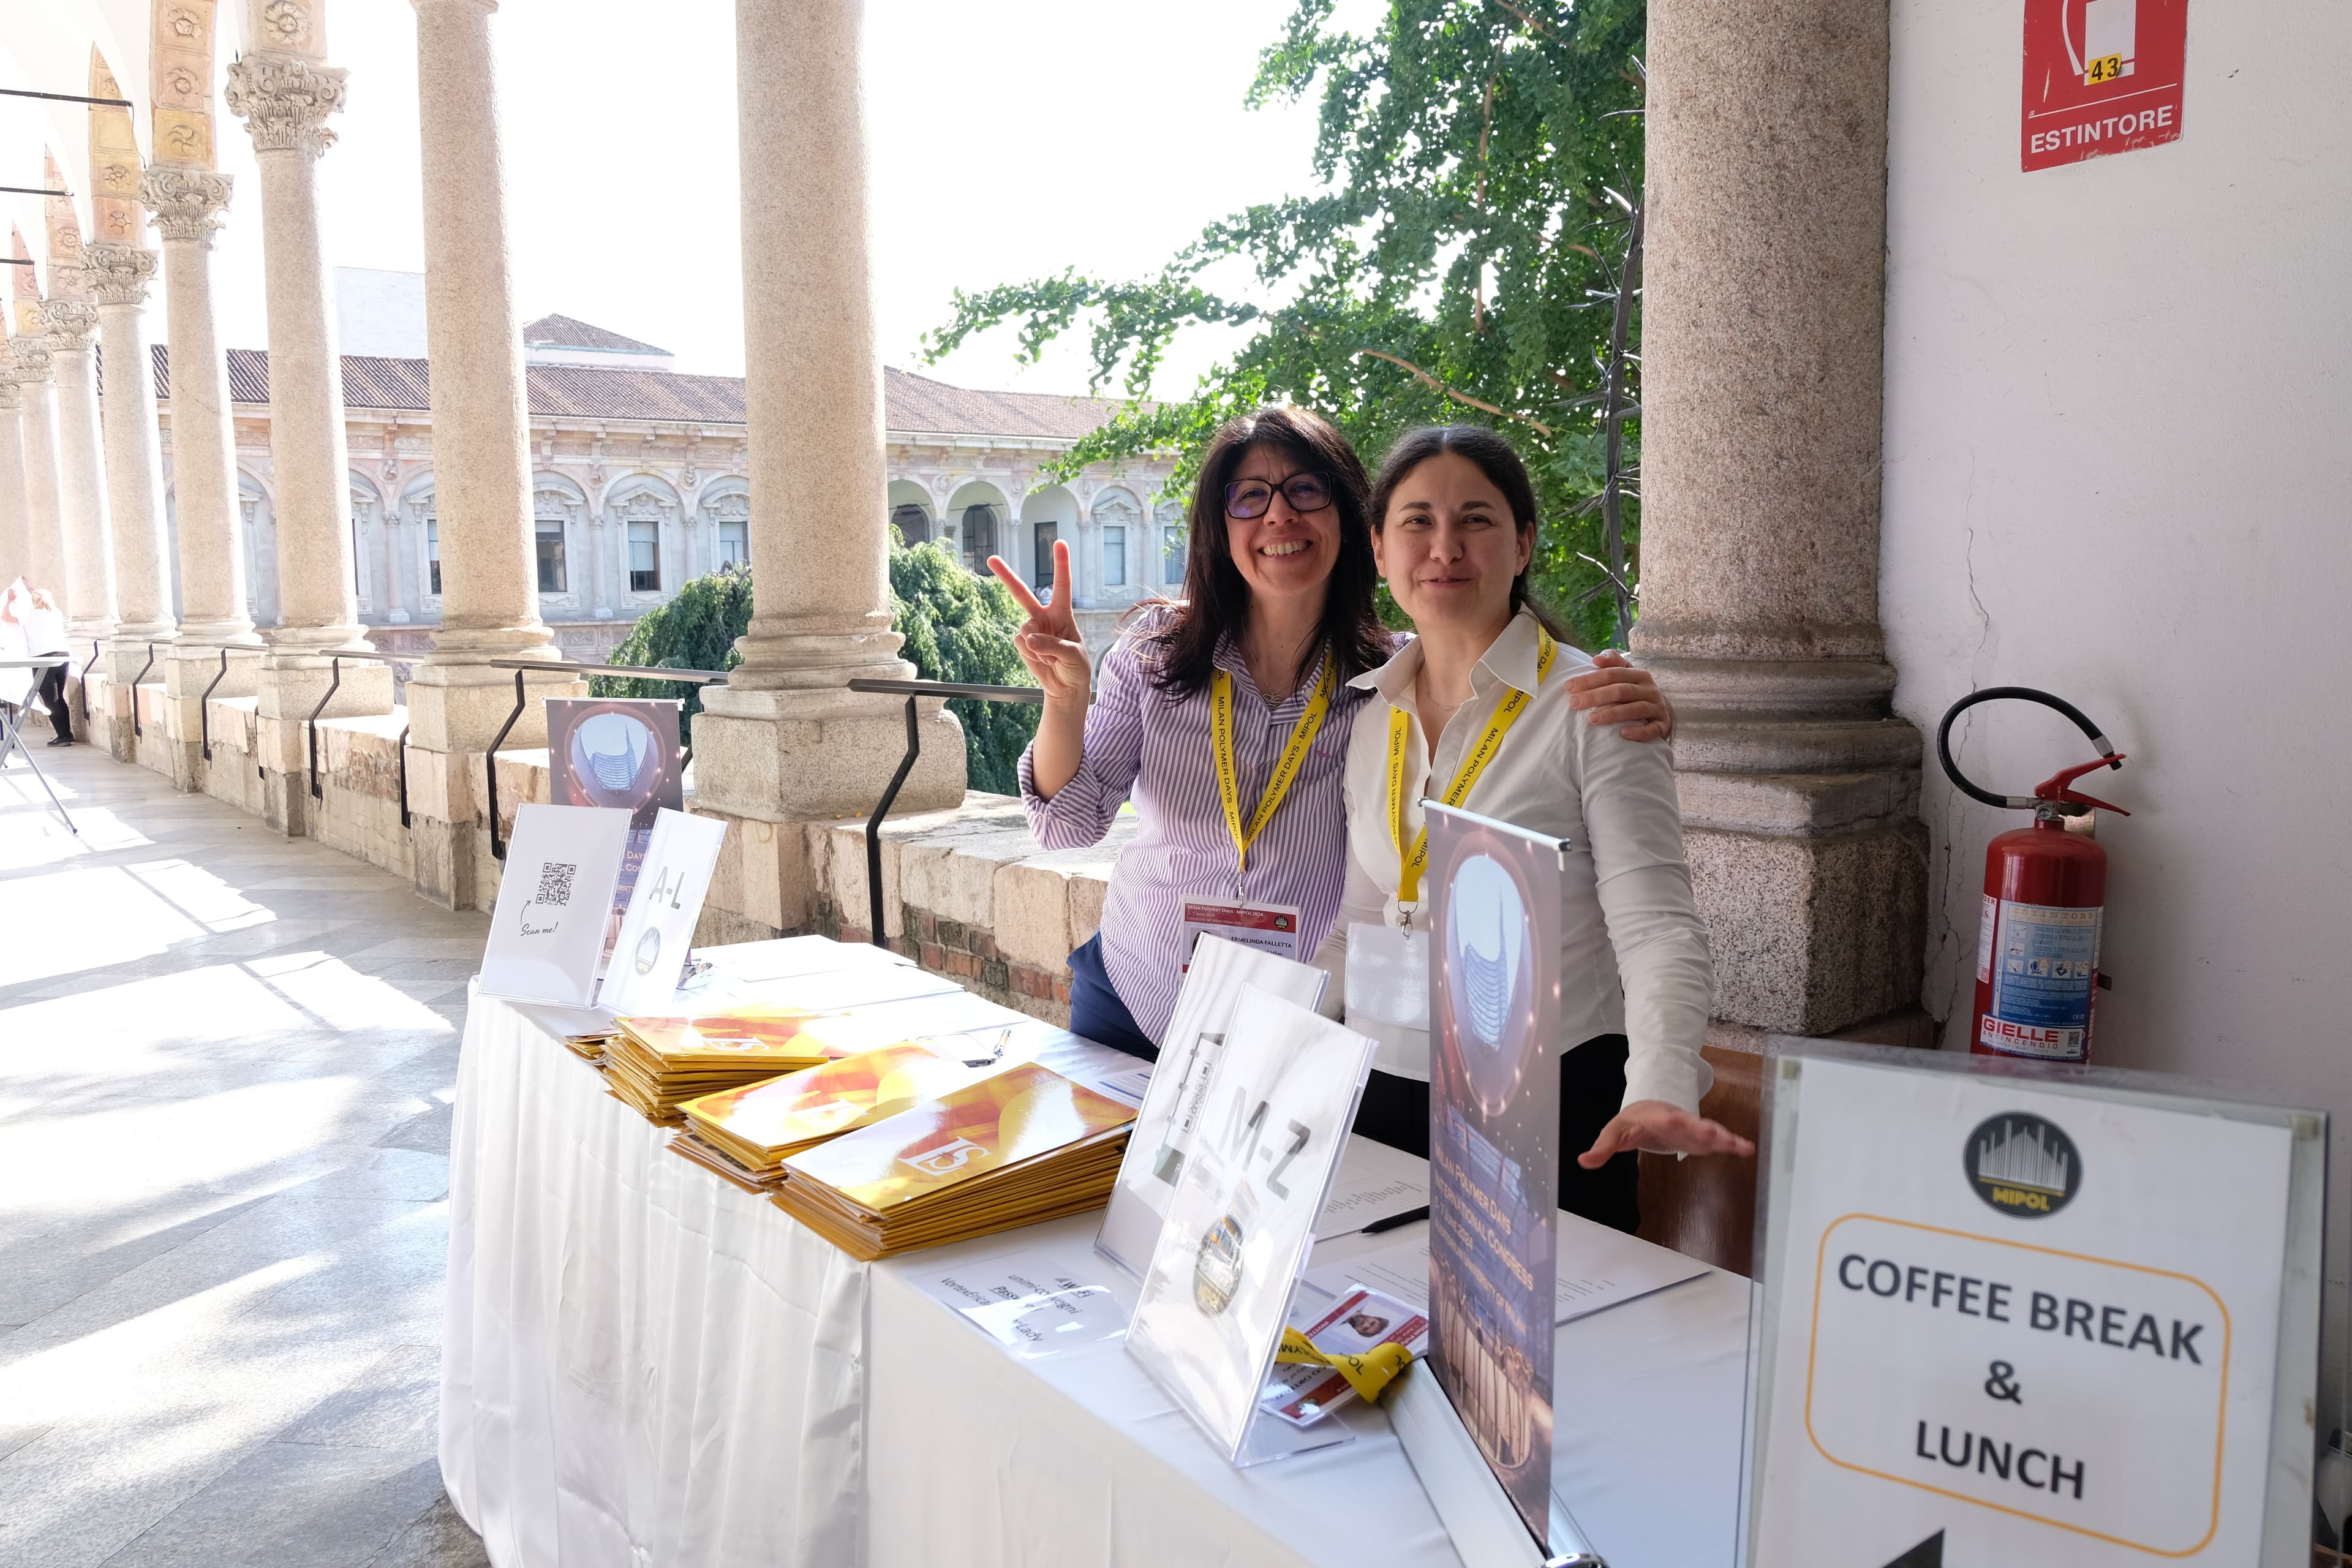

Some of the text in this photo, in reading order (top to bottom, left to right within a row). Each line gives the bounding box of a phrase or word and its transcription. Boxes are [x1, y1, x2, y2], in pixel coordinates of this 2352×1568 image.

[2090, 58, 2119, 81] 43
[2031, 105, 2173, 154] ESTINTORE
[1218, 728, 1229, 775] POLYMER
[1447, 728, 1498, 806] MILAN POLYMER
[1247, 814, 1264, 841] MILAN
[1262, 770, 1287, 813] POLYMER
[1284, 745, 1300, 770] DAYS
[1299, 712, 1317, 739] MIPOL
[649, 866, 685, 910] A-L
[520, 921, 559, 936] Scan me!
[1264, 940, 1292, 949] FALLETTA
[1983, 1018, 2059, 1043] GIELLE
[1983, 1031, 2058, 1049] ANTINCENDIO
[1218, 1086, 1311, 1200] M-Z
[1455, 1164, 1490, 1213] POLYMER
[1490, 1199, 1512, 1235] DAYS
[1991, 1186, 2051, 1212] MIPOL
[1434, 1169, 1534, 1292] INTERNATIONAL CONGRESS
[1838, 1254, 2204, 1365] COFFEE BREAK
[1984, 1360, 2022, 1405] &
[1916, 1420, 2085, 1501] LUNCH
